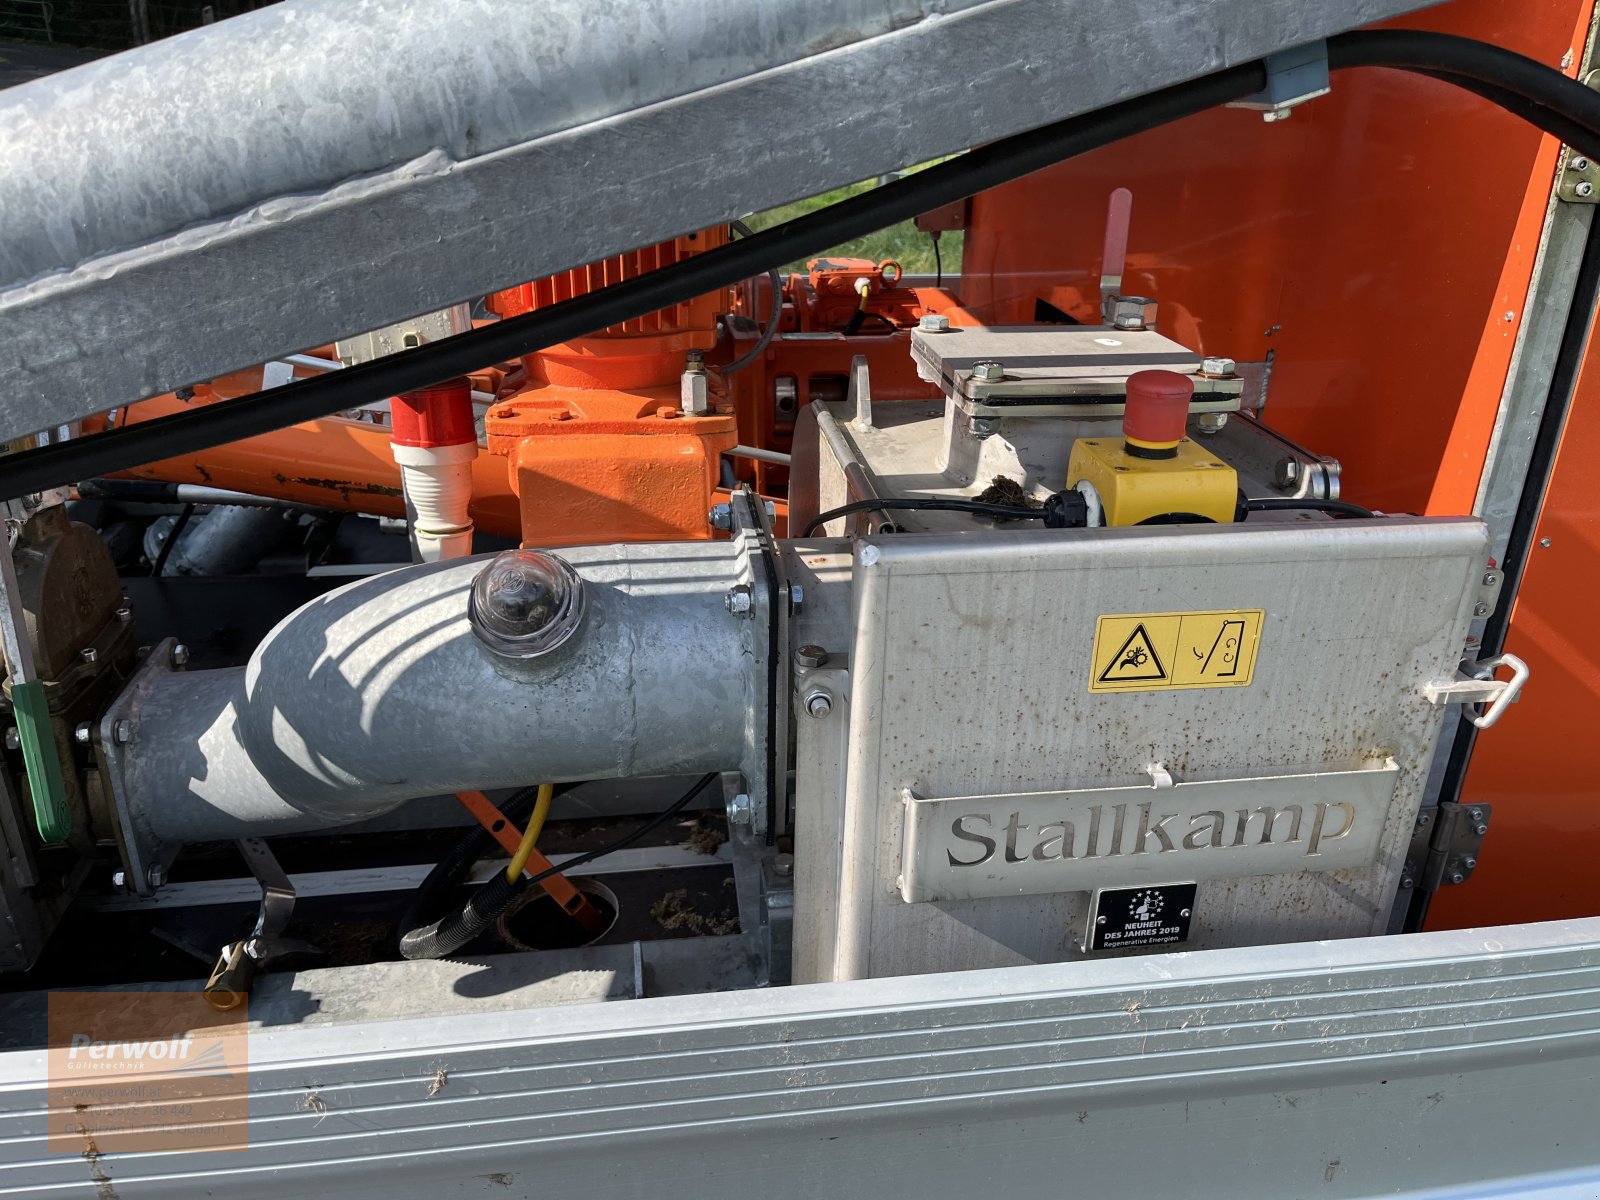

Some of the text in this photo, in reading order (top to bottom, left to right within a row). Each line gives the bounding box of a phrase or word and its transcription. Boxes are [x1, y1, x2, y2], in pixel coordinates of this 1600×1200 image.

[947, 801, 1355, 868] Stallkamp
[1124, 920, 1163, 930] NEUHEIT
[1104, 926, 1180, 940] DES JAHRES 2019
[1103, 935, 1179, 948] Regenerative Energien
